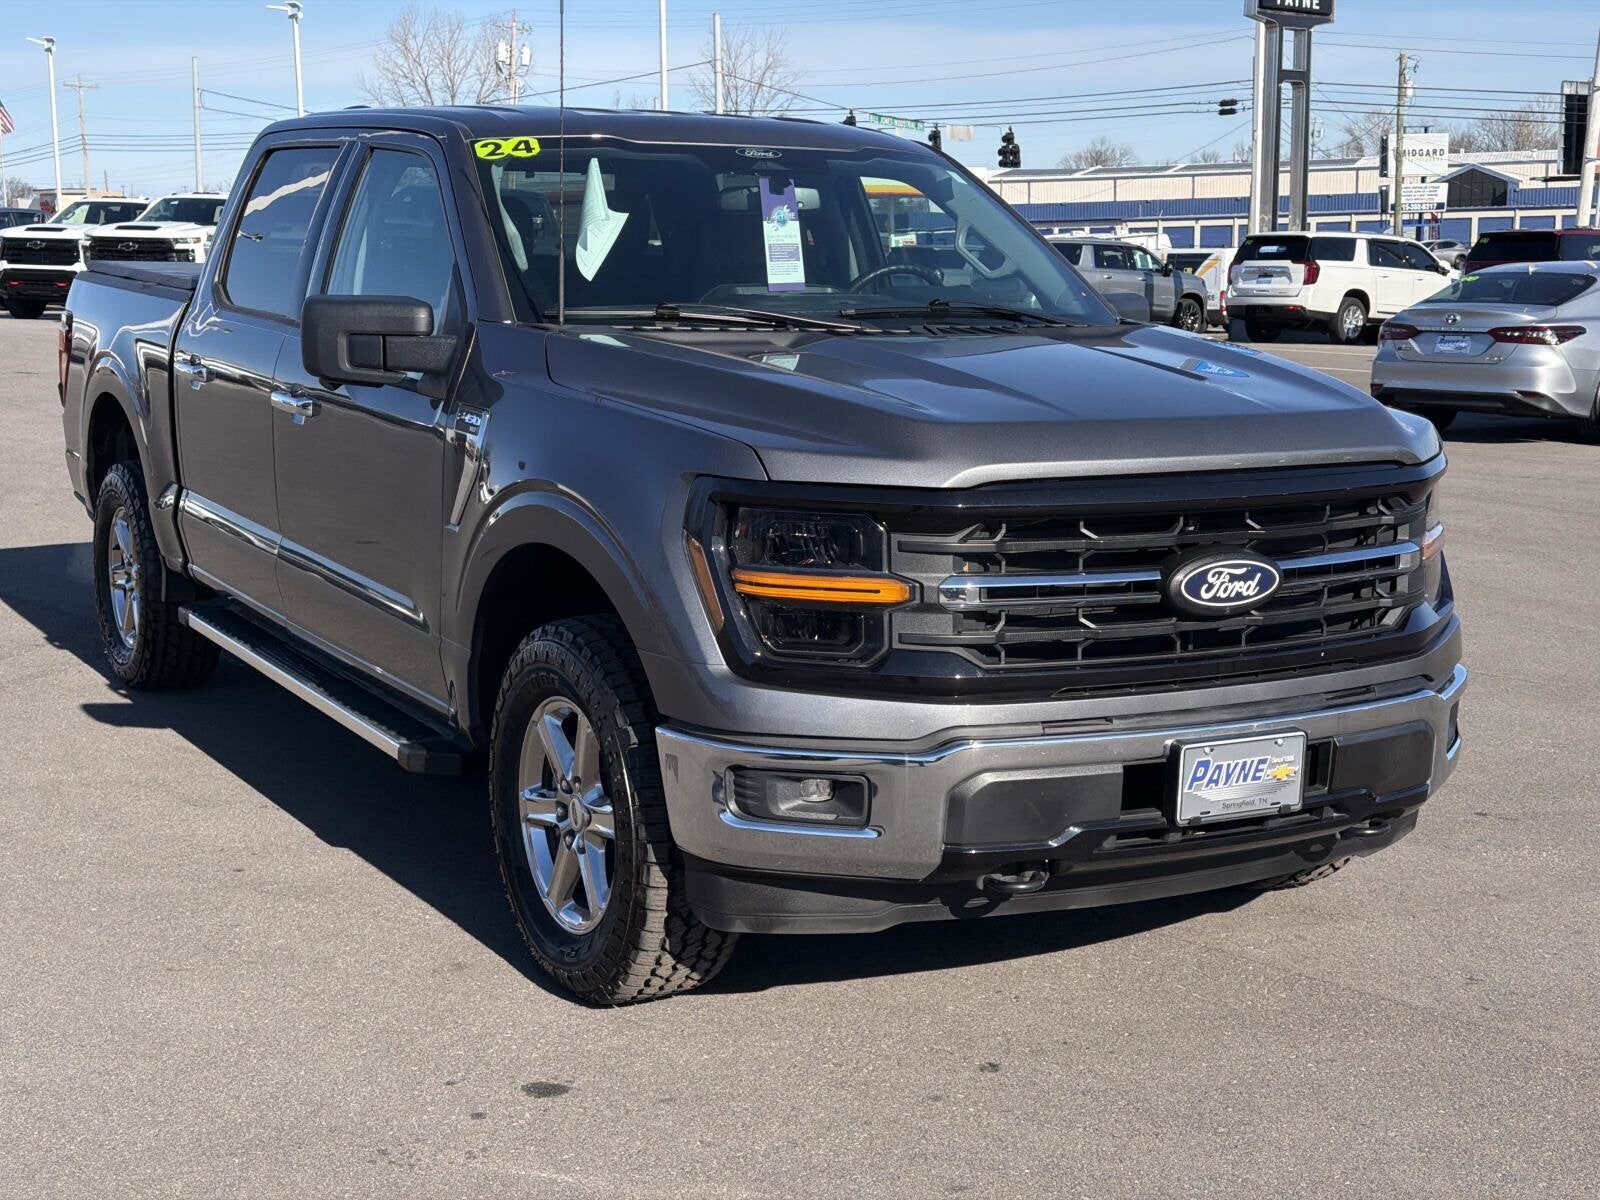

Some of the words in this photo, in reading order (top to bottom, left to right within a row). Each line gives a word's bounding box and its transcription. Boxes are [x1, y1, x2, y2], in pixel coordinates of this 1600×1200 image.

[480, 139, 536, 158] 24
[1200, 567, 1262, 600] Ford
[1185, 756, 1271, 792] PAYNE
[1222, 799, 1257, 810] Springfield,
[1259, 797, 1268, 805] TN
